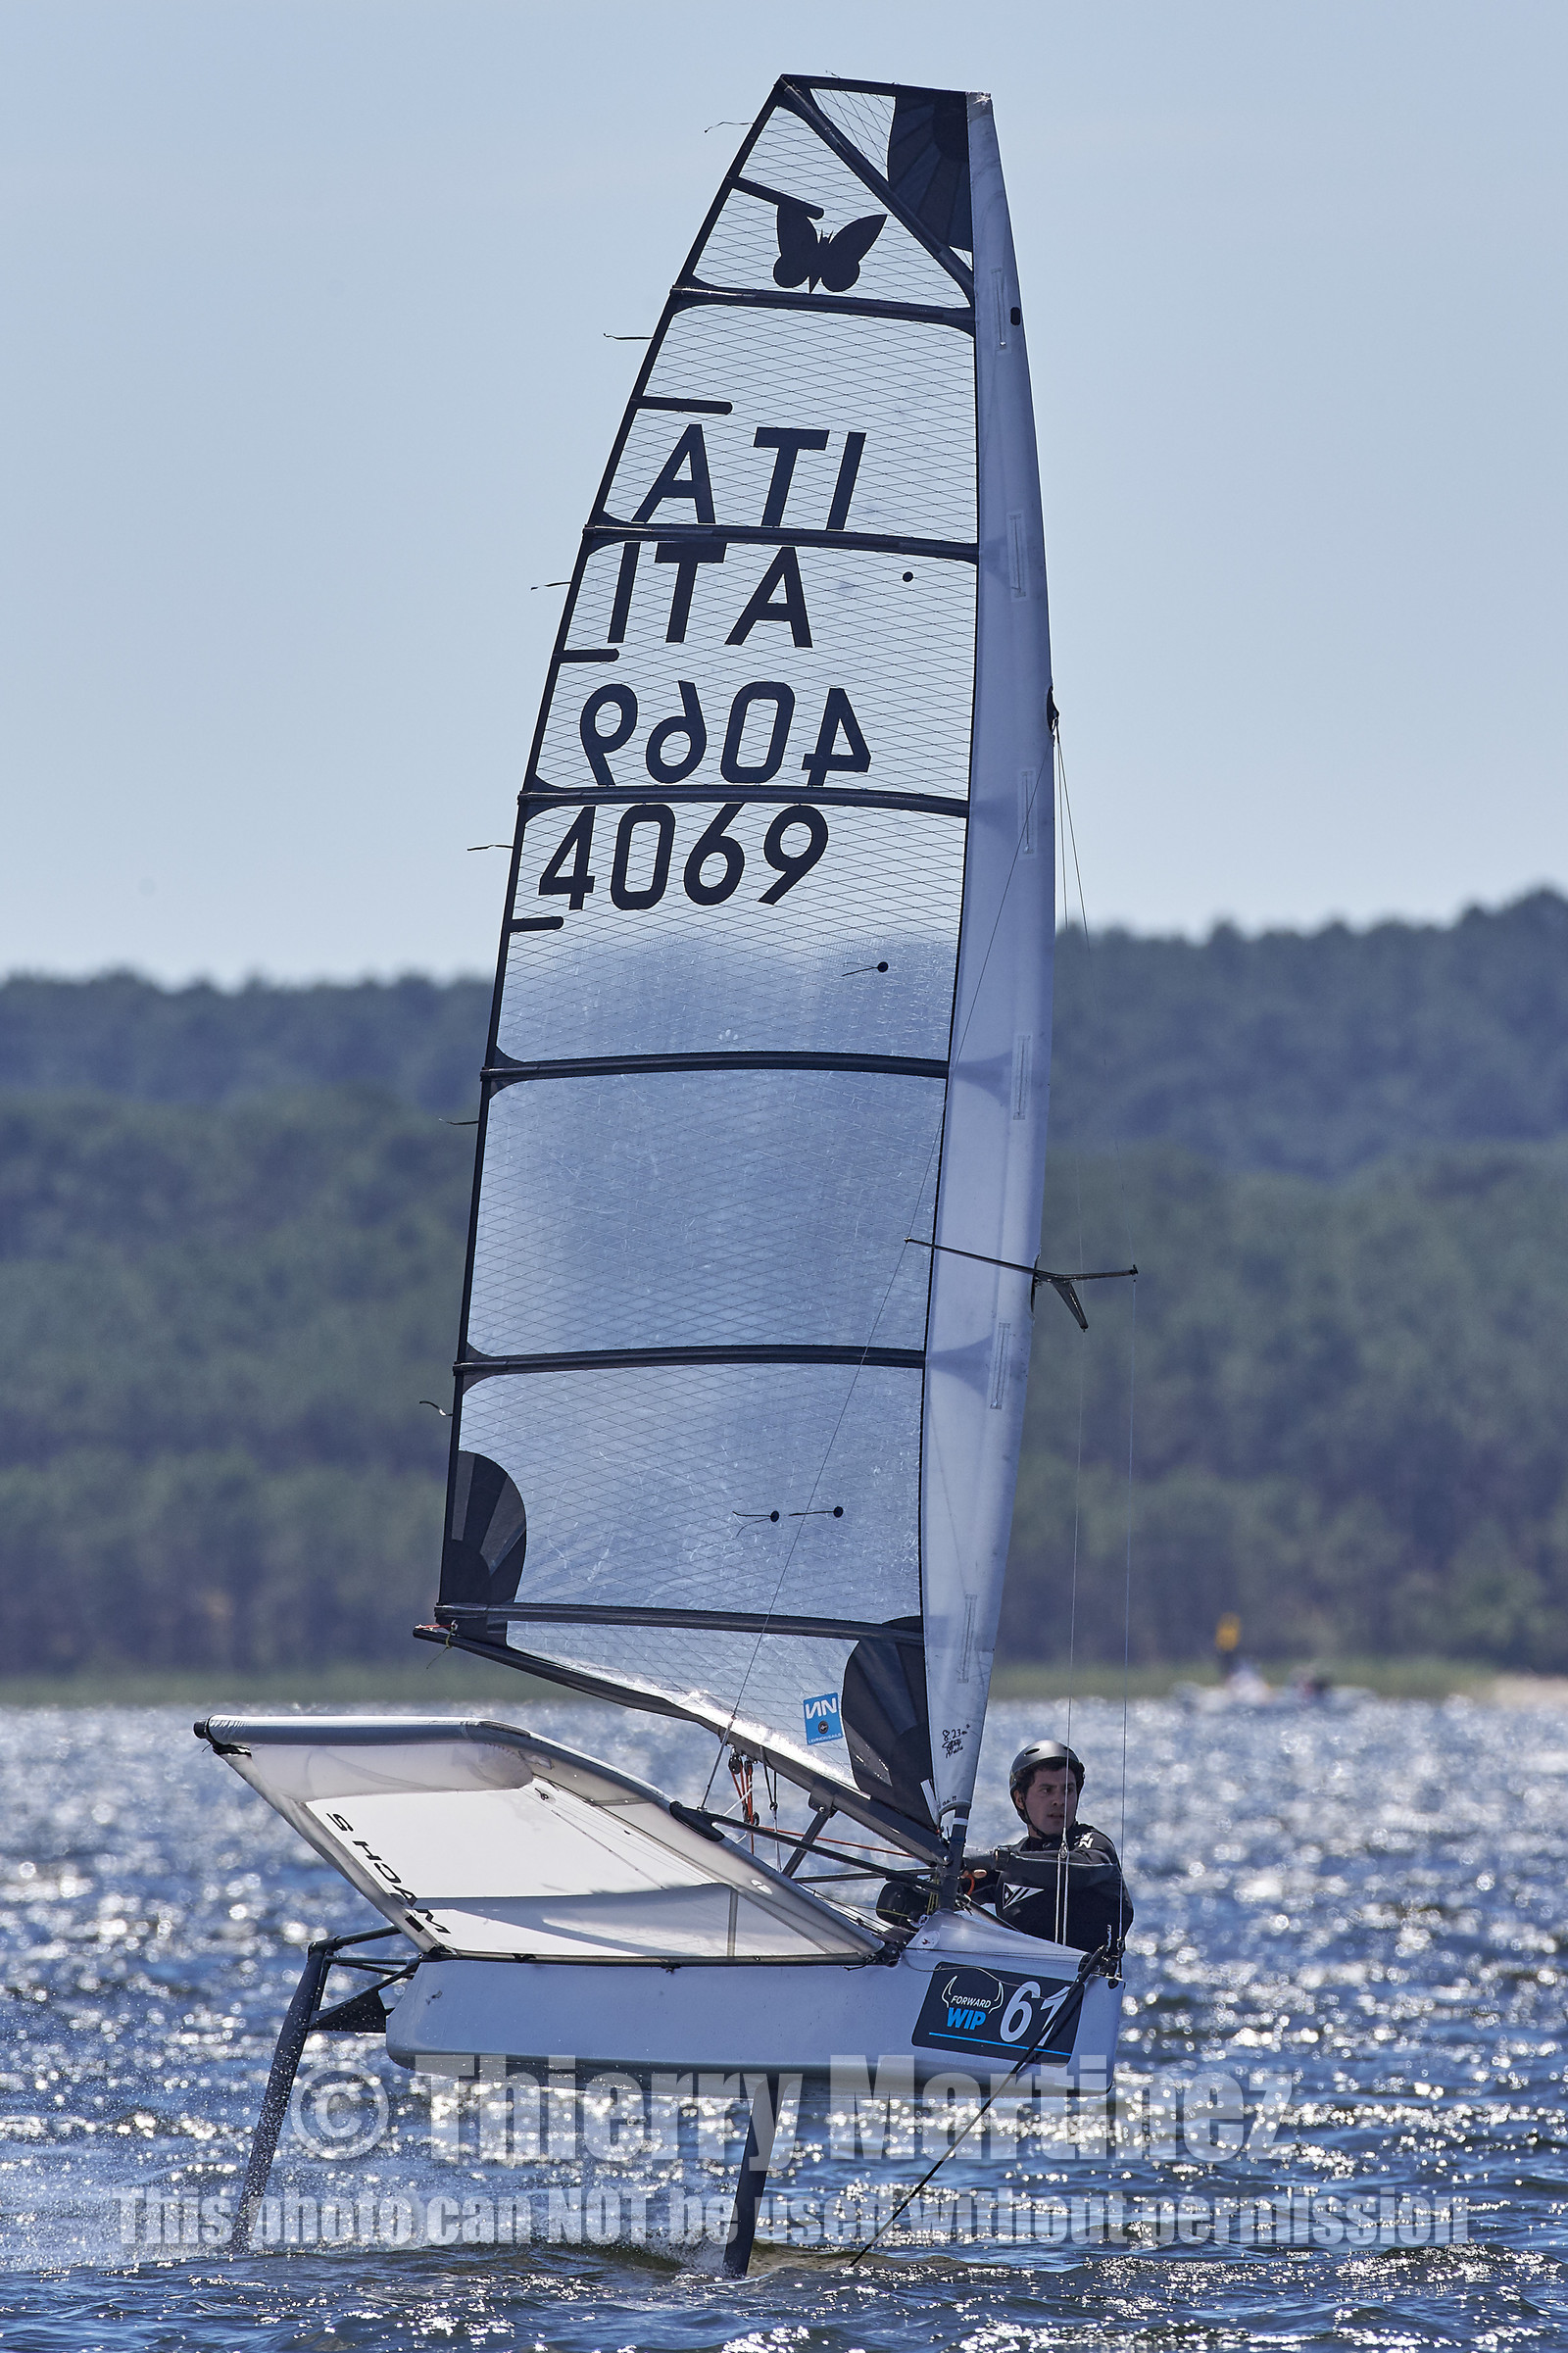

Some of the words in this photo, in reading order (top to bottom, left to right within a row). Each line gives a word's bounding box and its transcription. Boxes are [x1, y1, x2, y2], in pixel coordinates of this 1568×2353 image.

[607, 541, 813, 648] ITA
[538, 803, 829, 910] 4069
[947, 2007, 987, 2031] WIP
[951, 1994, 992, 2009] FORWARD
